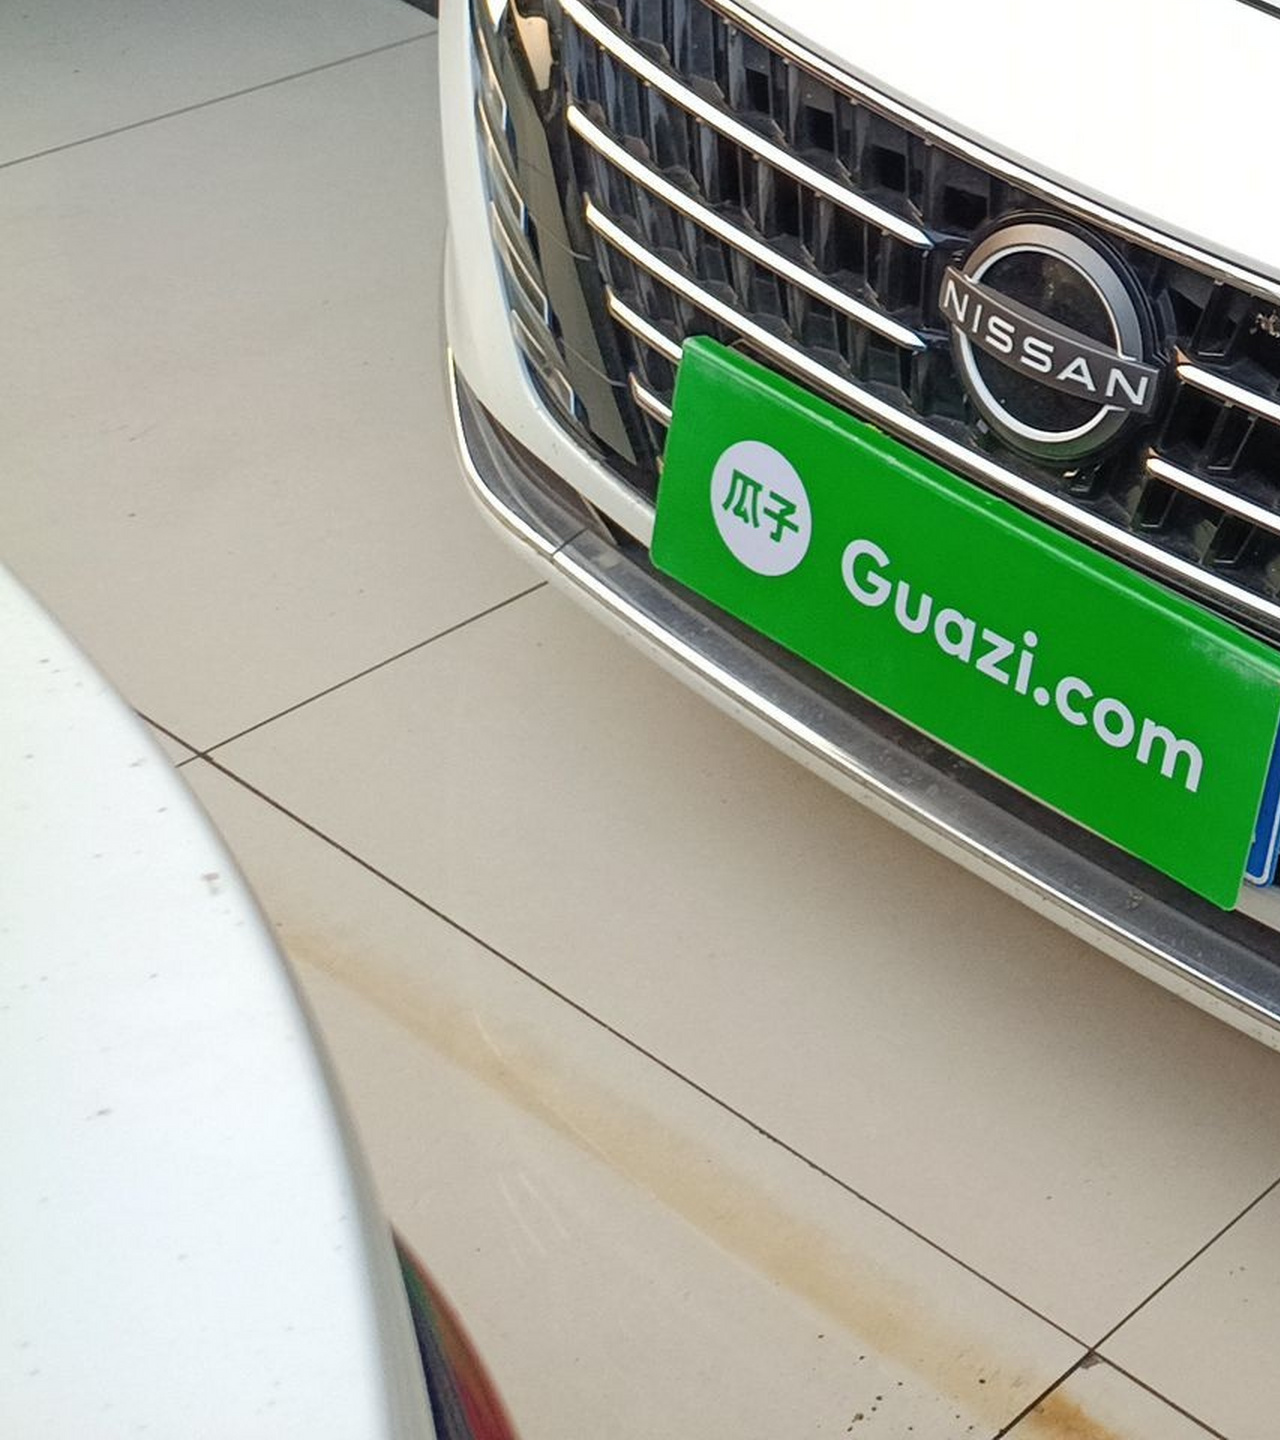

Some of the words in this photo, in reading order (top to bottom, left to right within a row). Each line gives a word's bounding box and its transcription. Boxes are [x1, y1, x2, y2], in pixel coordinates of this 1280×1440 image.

[942, 278, 1151, 407] NISSAN
[721, 469, 800, 543] 瓜子
[840, 539, 1204, 793] Guazi.com
